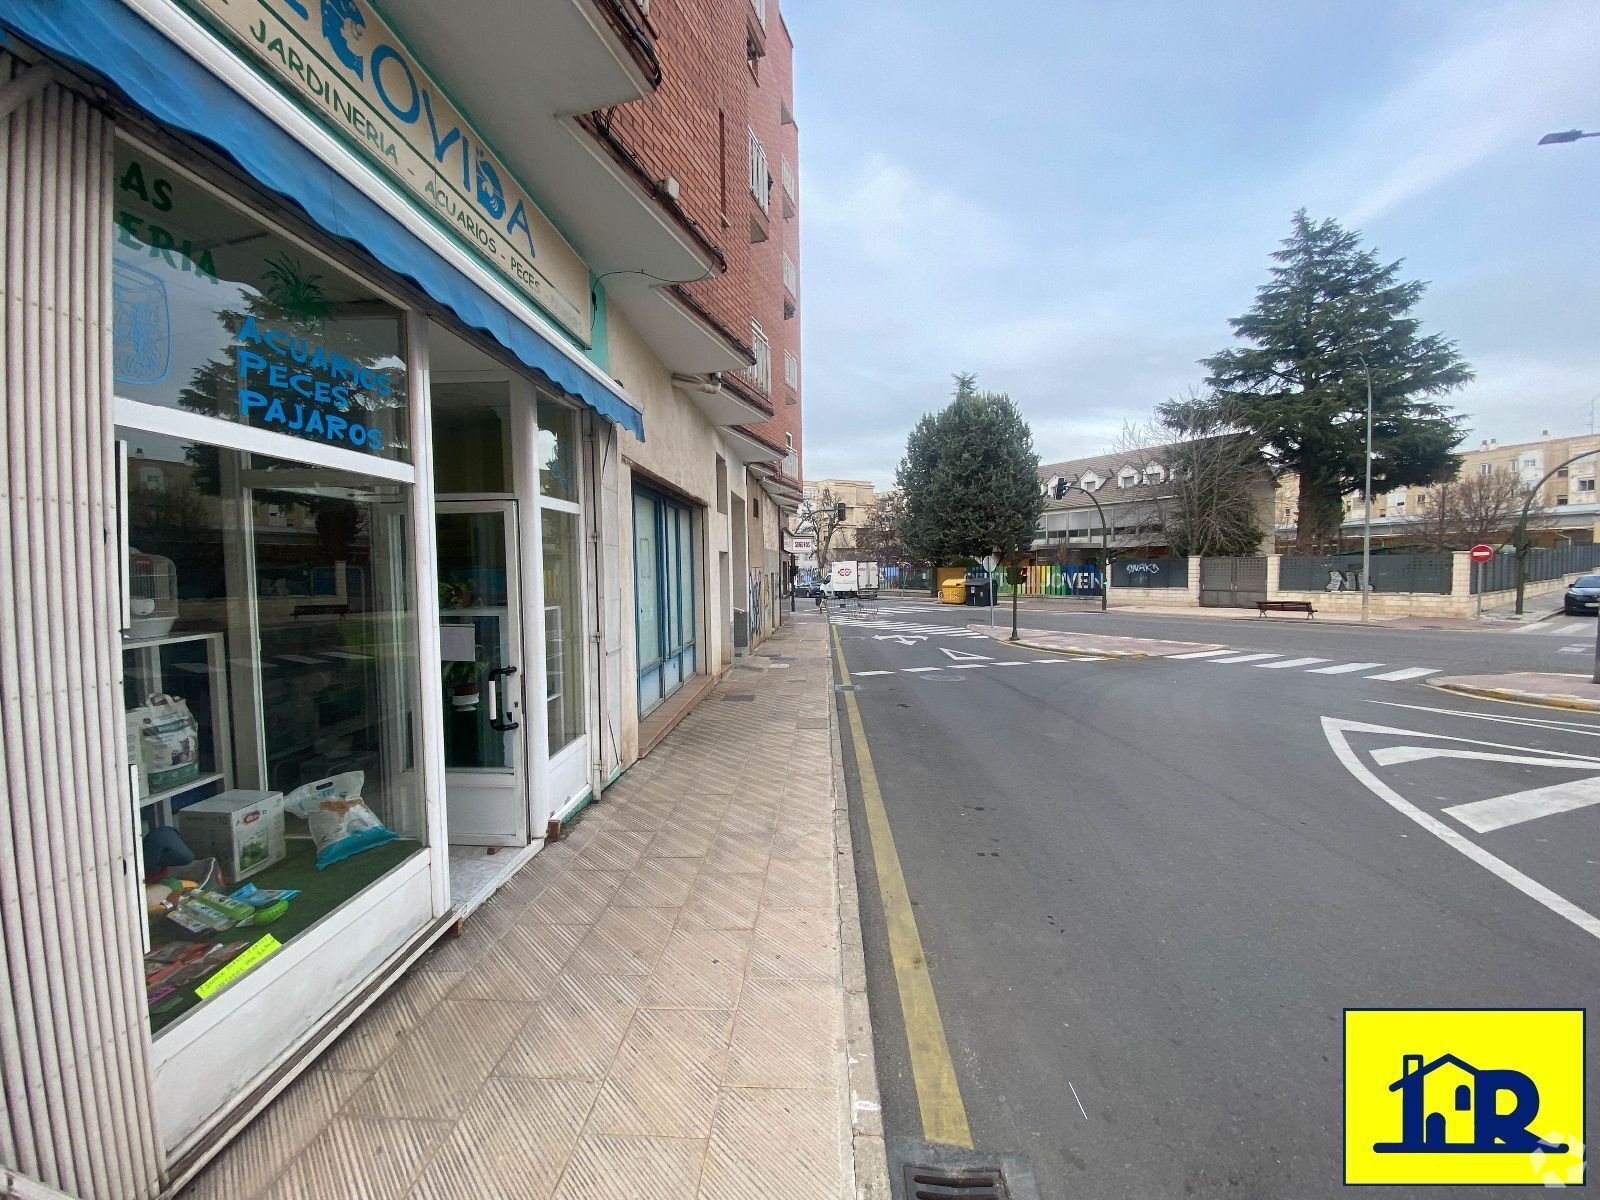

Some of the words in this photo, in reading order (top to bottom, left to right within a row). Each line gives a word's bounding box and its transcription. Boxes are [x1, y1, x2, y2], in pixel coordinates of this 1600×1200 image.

[249, 19, 398, 165] JARDINERIA
[425, 180, 497, 254] ACUARIOS
[510, 257, 540, 292] PECES
[285, 0, 536, 259] COVIDA
[237, 315, 392, 397] ACUARIOS
[238, 349, 350, 412] PECES
[238, 389, 385, 451] PAJAROS
